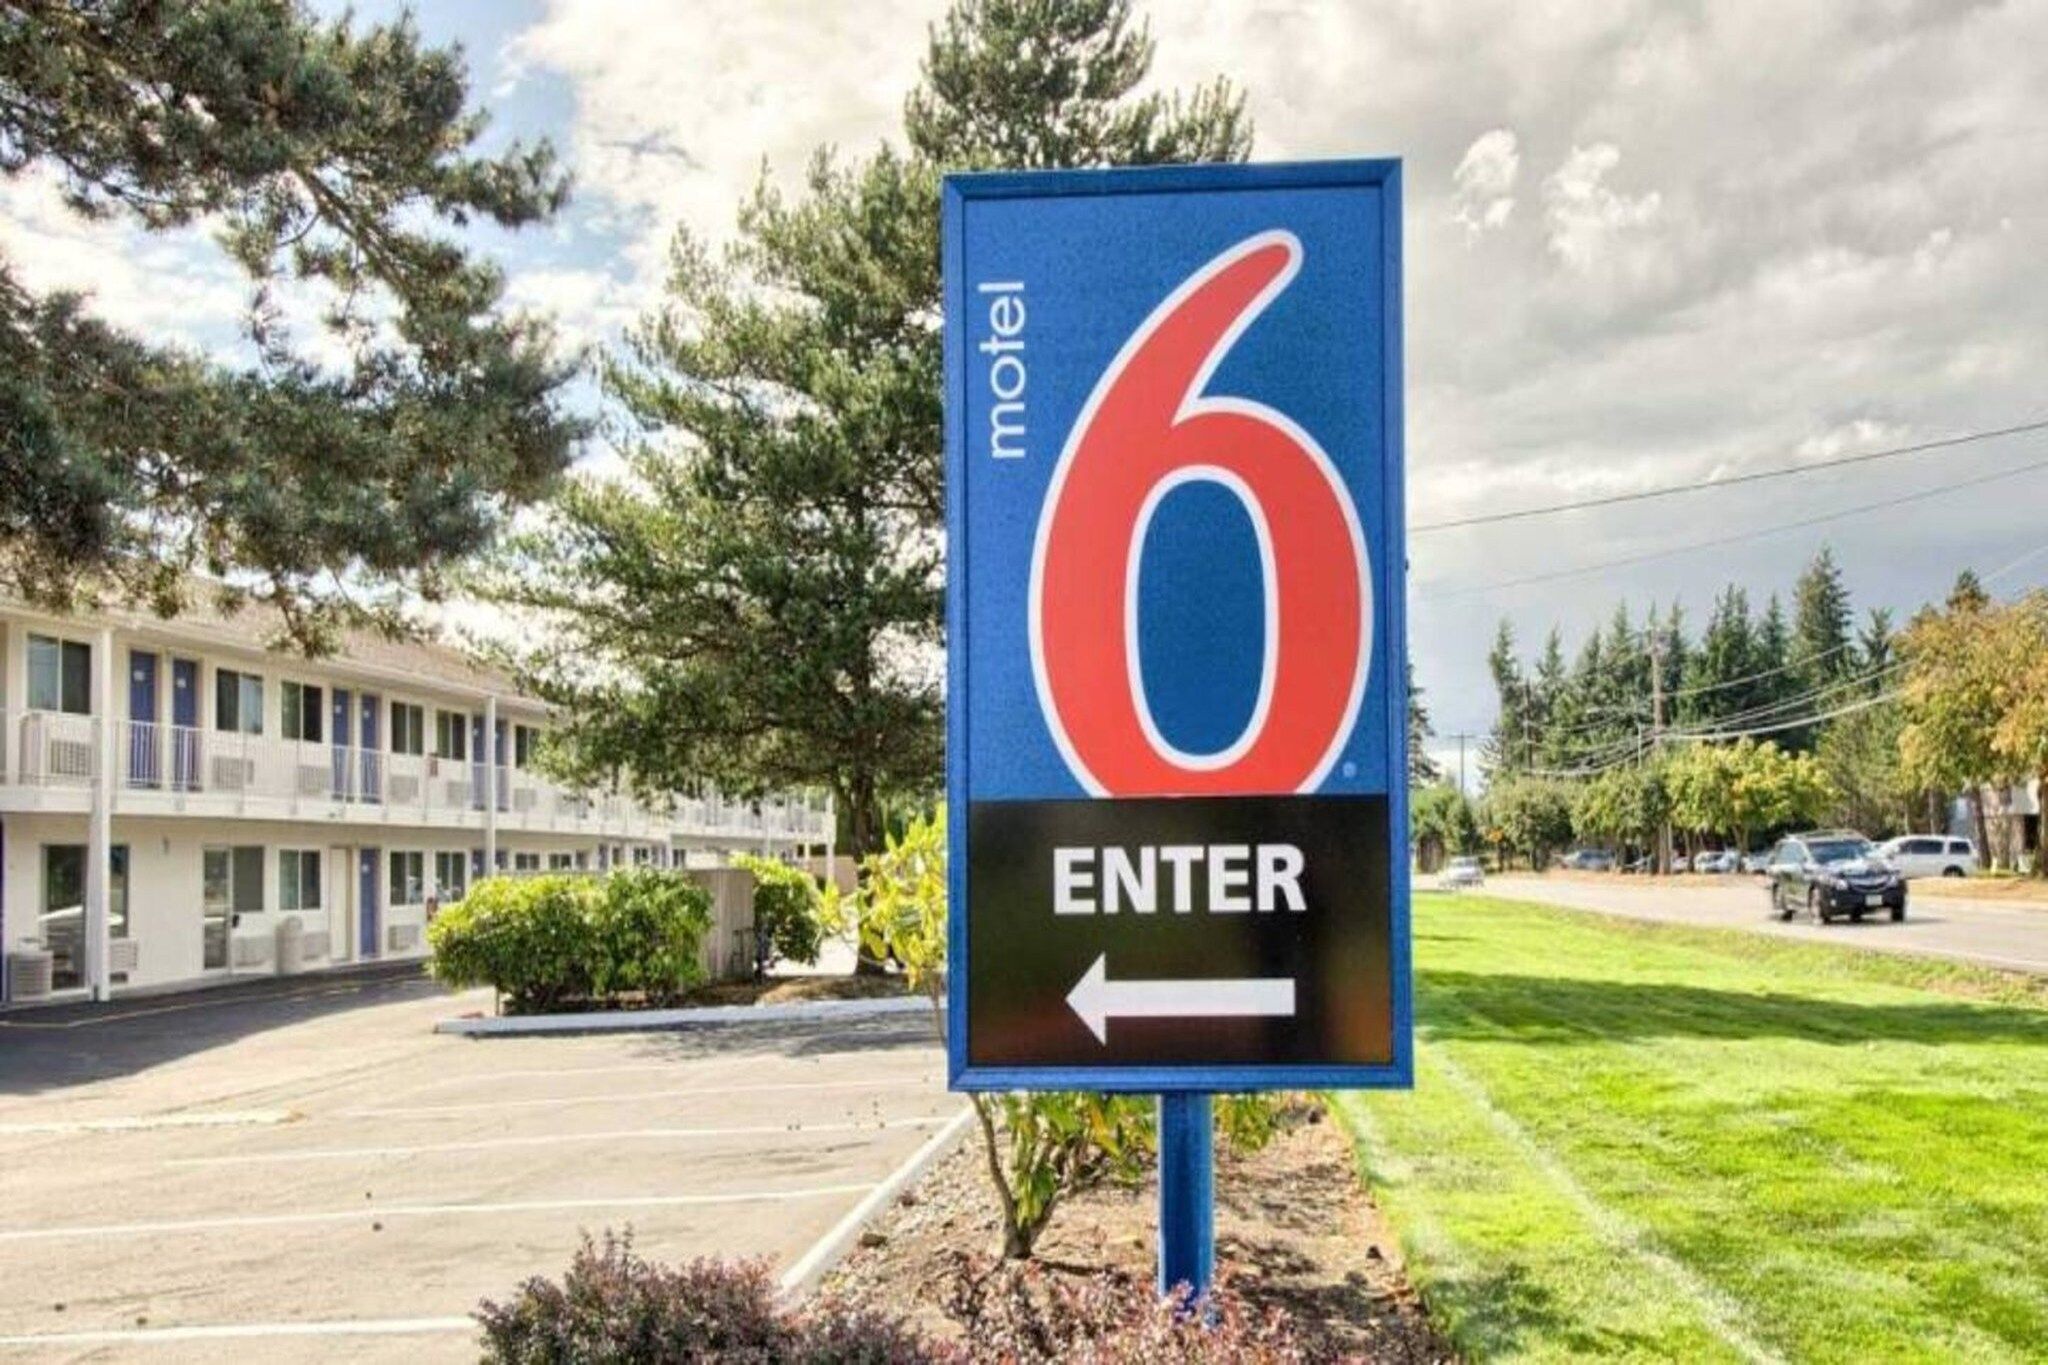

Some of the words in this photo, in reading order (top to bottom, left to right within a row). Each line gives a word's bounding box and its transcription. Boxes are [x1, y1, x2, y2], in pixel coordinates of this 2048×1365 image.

[979, 281, 1025, 459] motel
[1028, 229, 1374, 798] 6
[1053, 843, 1307, 915] ENTER
